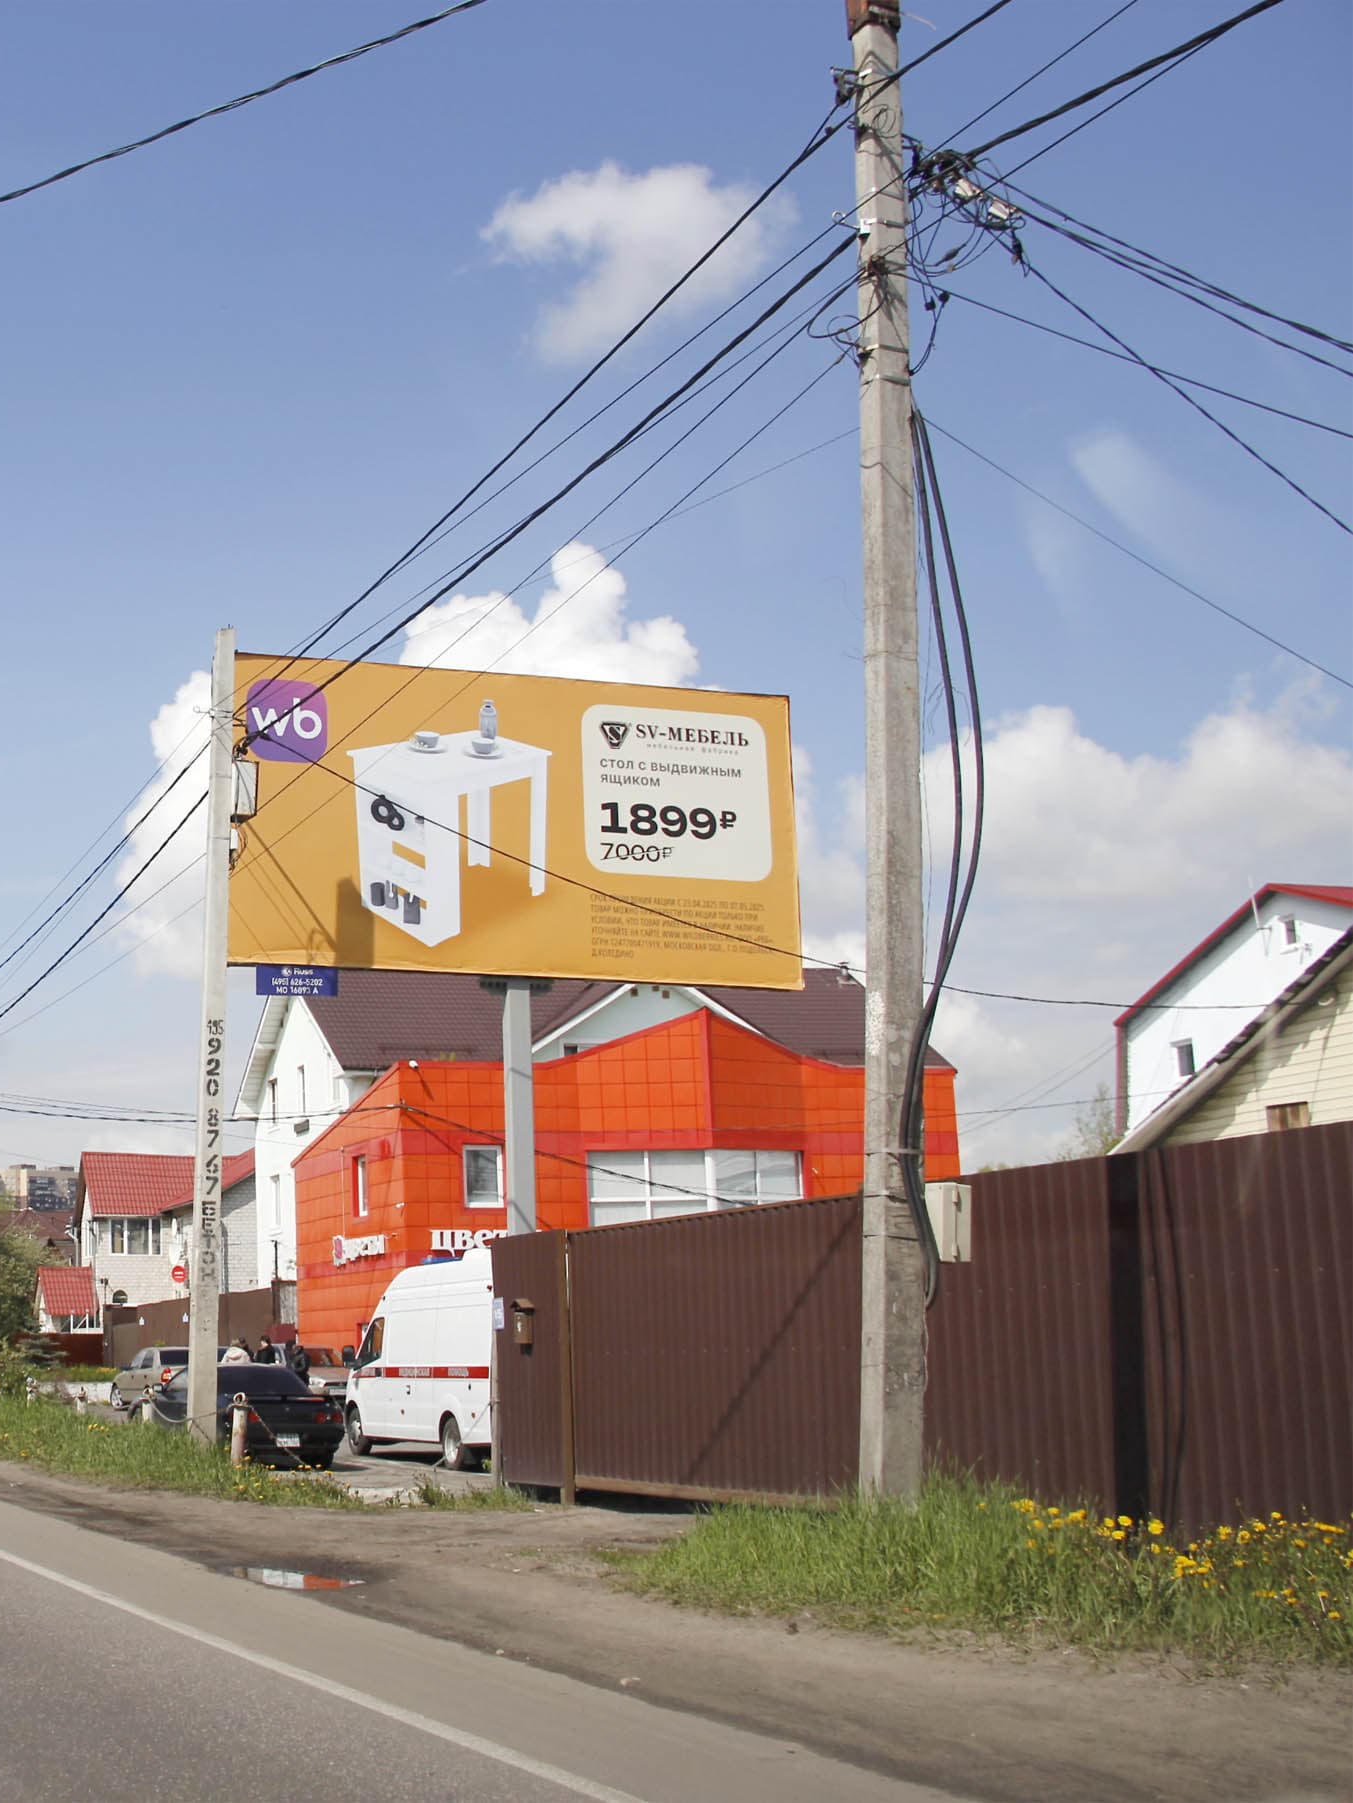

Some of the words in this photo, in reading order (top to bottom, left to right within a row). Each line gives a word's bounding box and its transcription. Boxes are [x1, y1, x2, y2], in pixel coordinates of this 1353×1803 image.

[251, 697, 322, 739] wb
[636, 724, 749, 747] SV-МЕБЕЛЬ
[650, 763, 741, 778] ВЫДВИЖНЫМ
[600, 774, 660, 787] ЯЩИКОМ
[290, 978, 323, 986] 626-5202
